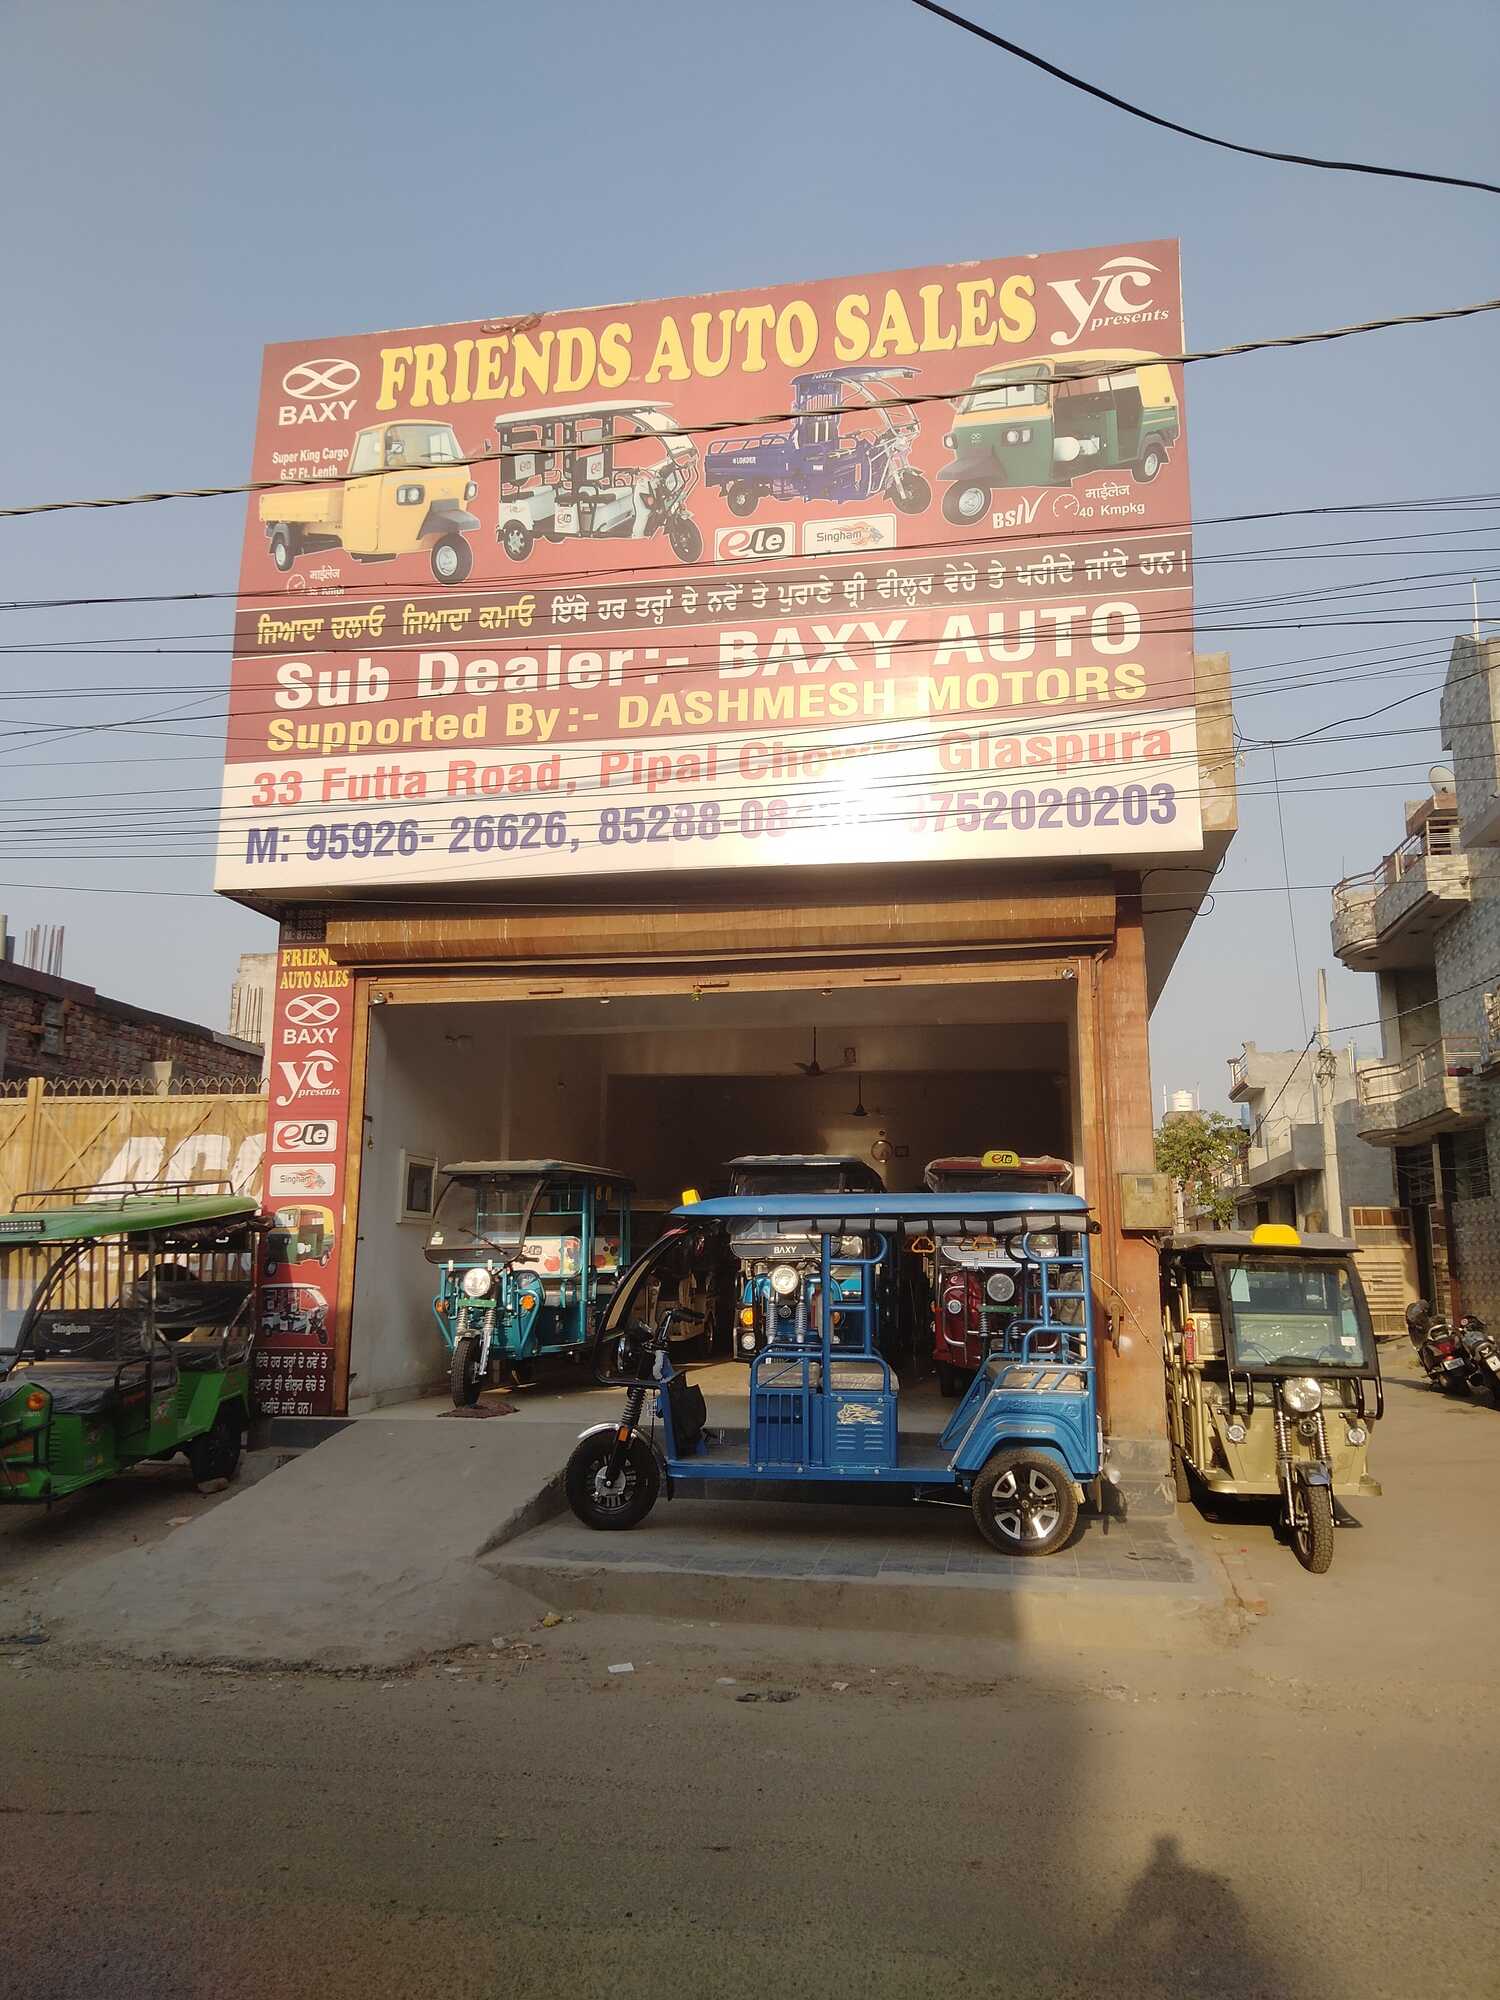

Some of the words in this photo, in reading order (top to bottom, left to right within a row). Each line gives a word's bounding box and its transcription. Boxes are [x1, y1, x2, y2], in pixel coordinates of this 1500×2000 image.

[1090, 309, 1169, 331] presents
[376, 322, 633, 411] FRIENDS
[645, 300, 820, 384] AUTO
[834, 274, 1037, 362] SALES
[279, 400, 357, 426] BAXY
[272, 451, 298, 465] Super
[300, 449, 321, 463] King
[322, 447, 350, 462] Cargo
[1085, 483, 1131, 500] माईलेज
[992, 490, 1049, 529] BSIV
[1079, 507, 1094, 518] 40
[1100, 502, 1145, 517] Kmpkg
[816, 529, 862, 544] Singham
[597, 598, 628, 620] ਹਰ
[681, 586, 698, 614] ਦੇ
[751, 580, 769, 608] ਤੇ
[988, 559, 1007, 589] ਤੇ
[274, 657, 390, 709] Sub
[718, 618, 908, 679] BAXY
[933, 601, 1142, 666] AUTO
[267, 705, 487, 754] Supported
[618, 678, 897, 729] DASHMESH
[912, 663, 1147, 712] MOTORS
[252, 770, 303, 807] 33
[321, 765, 427, 803] Futta
[448, 754, 577, 796] Road,
[599, 744, 718, 793] Pipal
[246, 826, 290, 865] M:
[448, 810, 580, 853] 26626,
[280, 971, 312, 989] AUTO
[313, 969, 349, 989] SALES
[283, 1028, 338, 1044] BAXY
[298, 1087, 341, 1098] presents
[280, 1174, 311, 1184] Singham
[773, 1246, 797, 1254] BAXY
[52, 1323, 90, 1336] Singham
